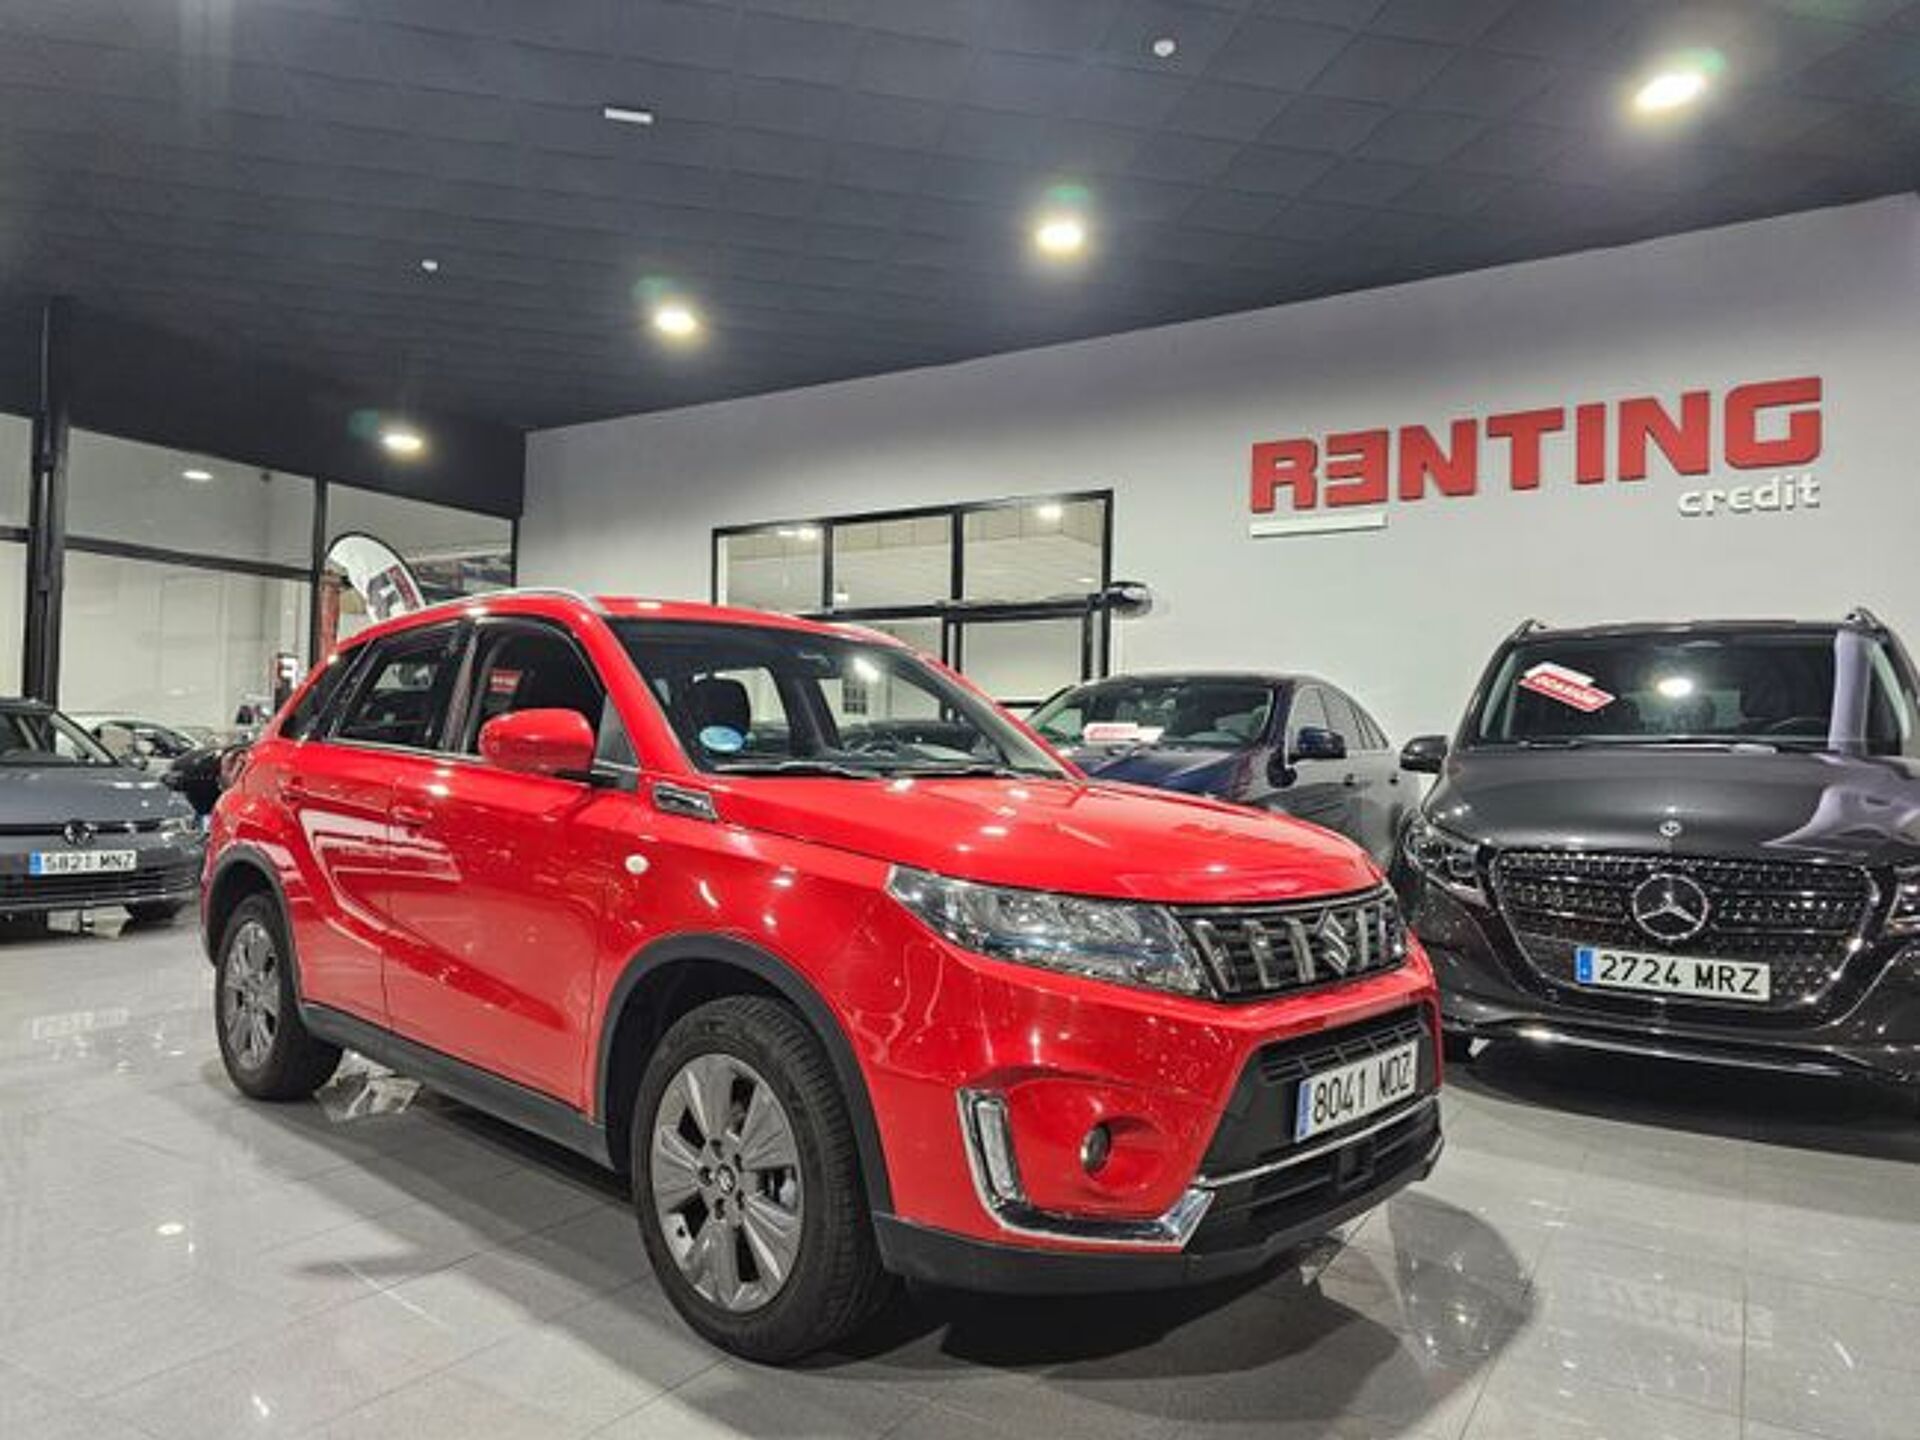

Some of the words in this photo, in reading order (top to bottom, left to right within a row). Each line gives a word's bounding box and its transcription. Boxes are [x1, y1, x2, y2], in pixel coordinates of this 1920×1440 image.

[1250, 376, 1823, 514] RENTING
[1677, 473, 1821, 517] credit
[1600, 953, 1681, 987] 2724
[1694, 962, 1761, 995] MRZ
[1313, 1067, 1367, 1125] 8041
[1378, 1050, 1412, 1098] MDZ
